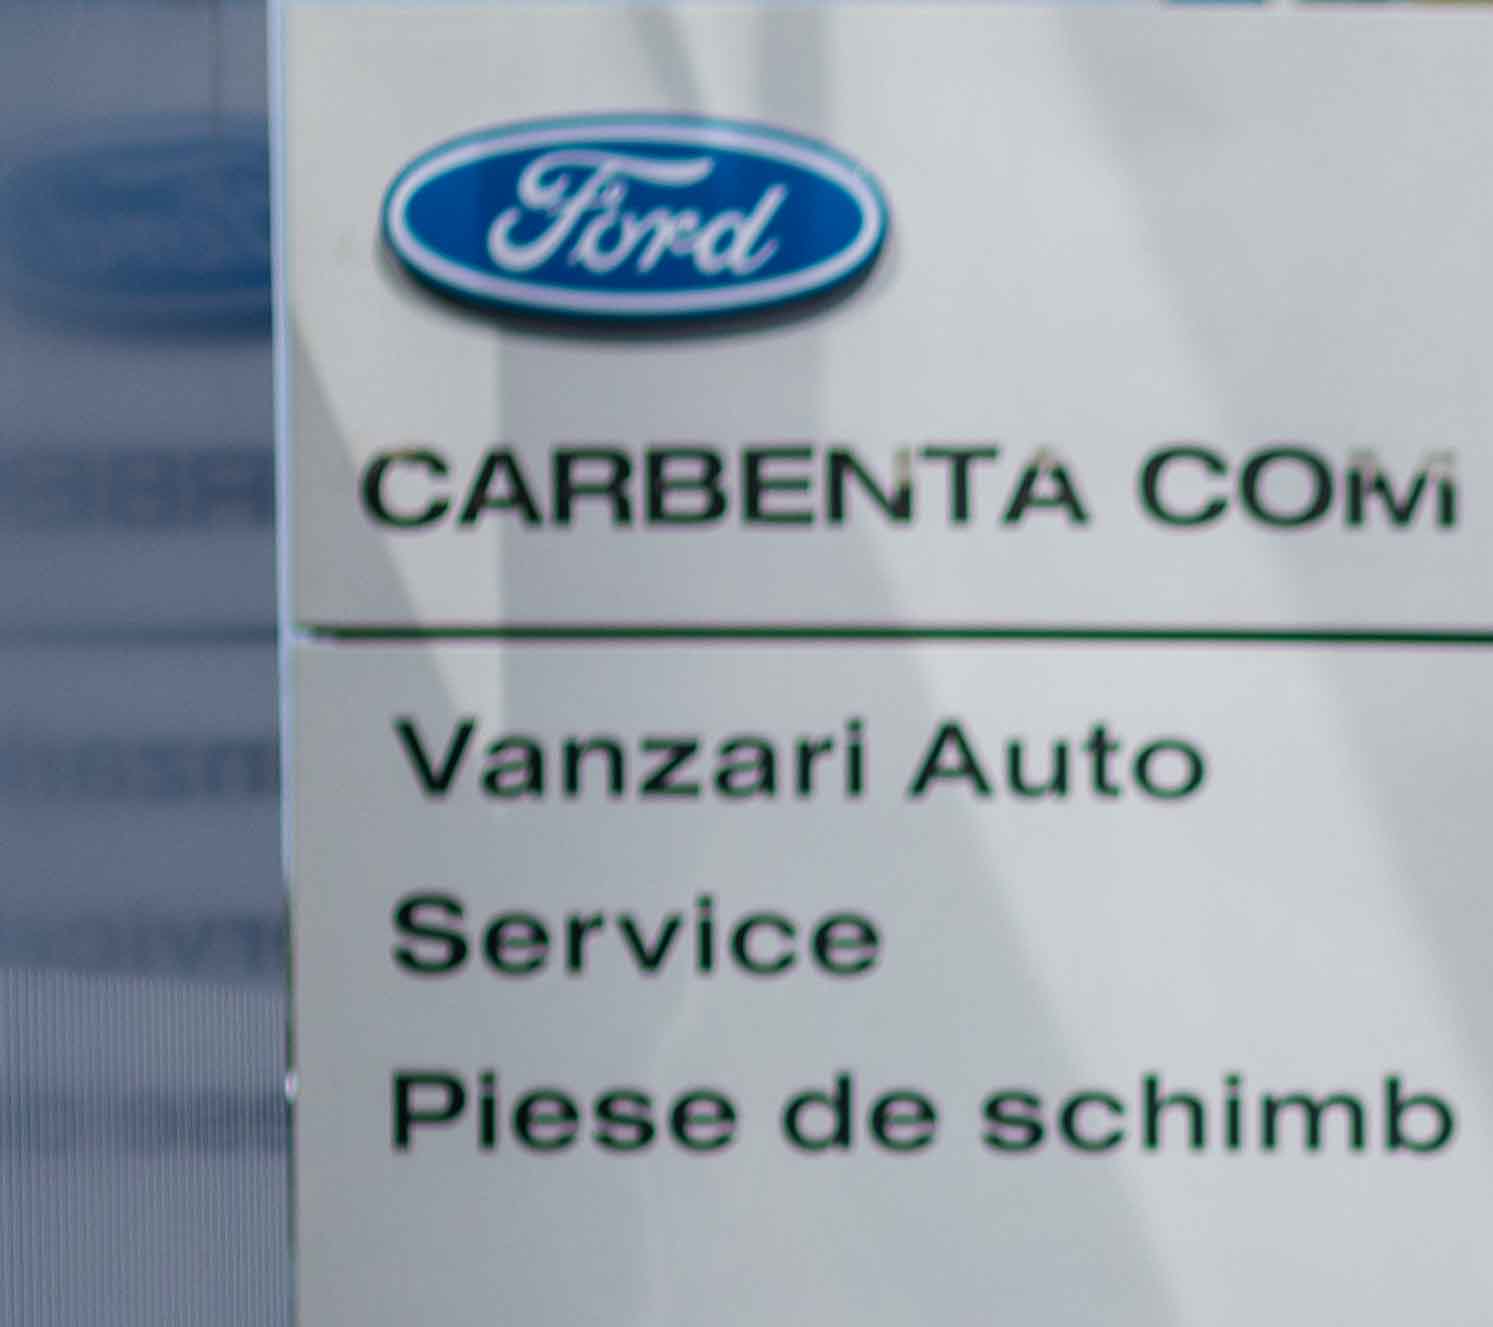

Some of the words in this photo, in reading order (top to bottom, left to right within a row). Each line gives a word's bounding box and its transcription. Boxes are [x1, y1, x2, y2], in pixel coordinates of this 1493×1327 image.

[486, 148, 788, 276] Ford
[358, 445, 1087, 530] CARBENTA
[1141, 447, 1456, 528] COM
[394, 716, 869, 800] Vanzari
[908, 719, 1207, 801] Auto
[390, 892, 882, 976] Service
[391, 1069, 738, 1154] Piese
[781, 1071, 939, 1153] de
[980, 1072, 1458, 1154] schimb
